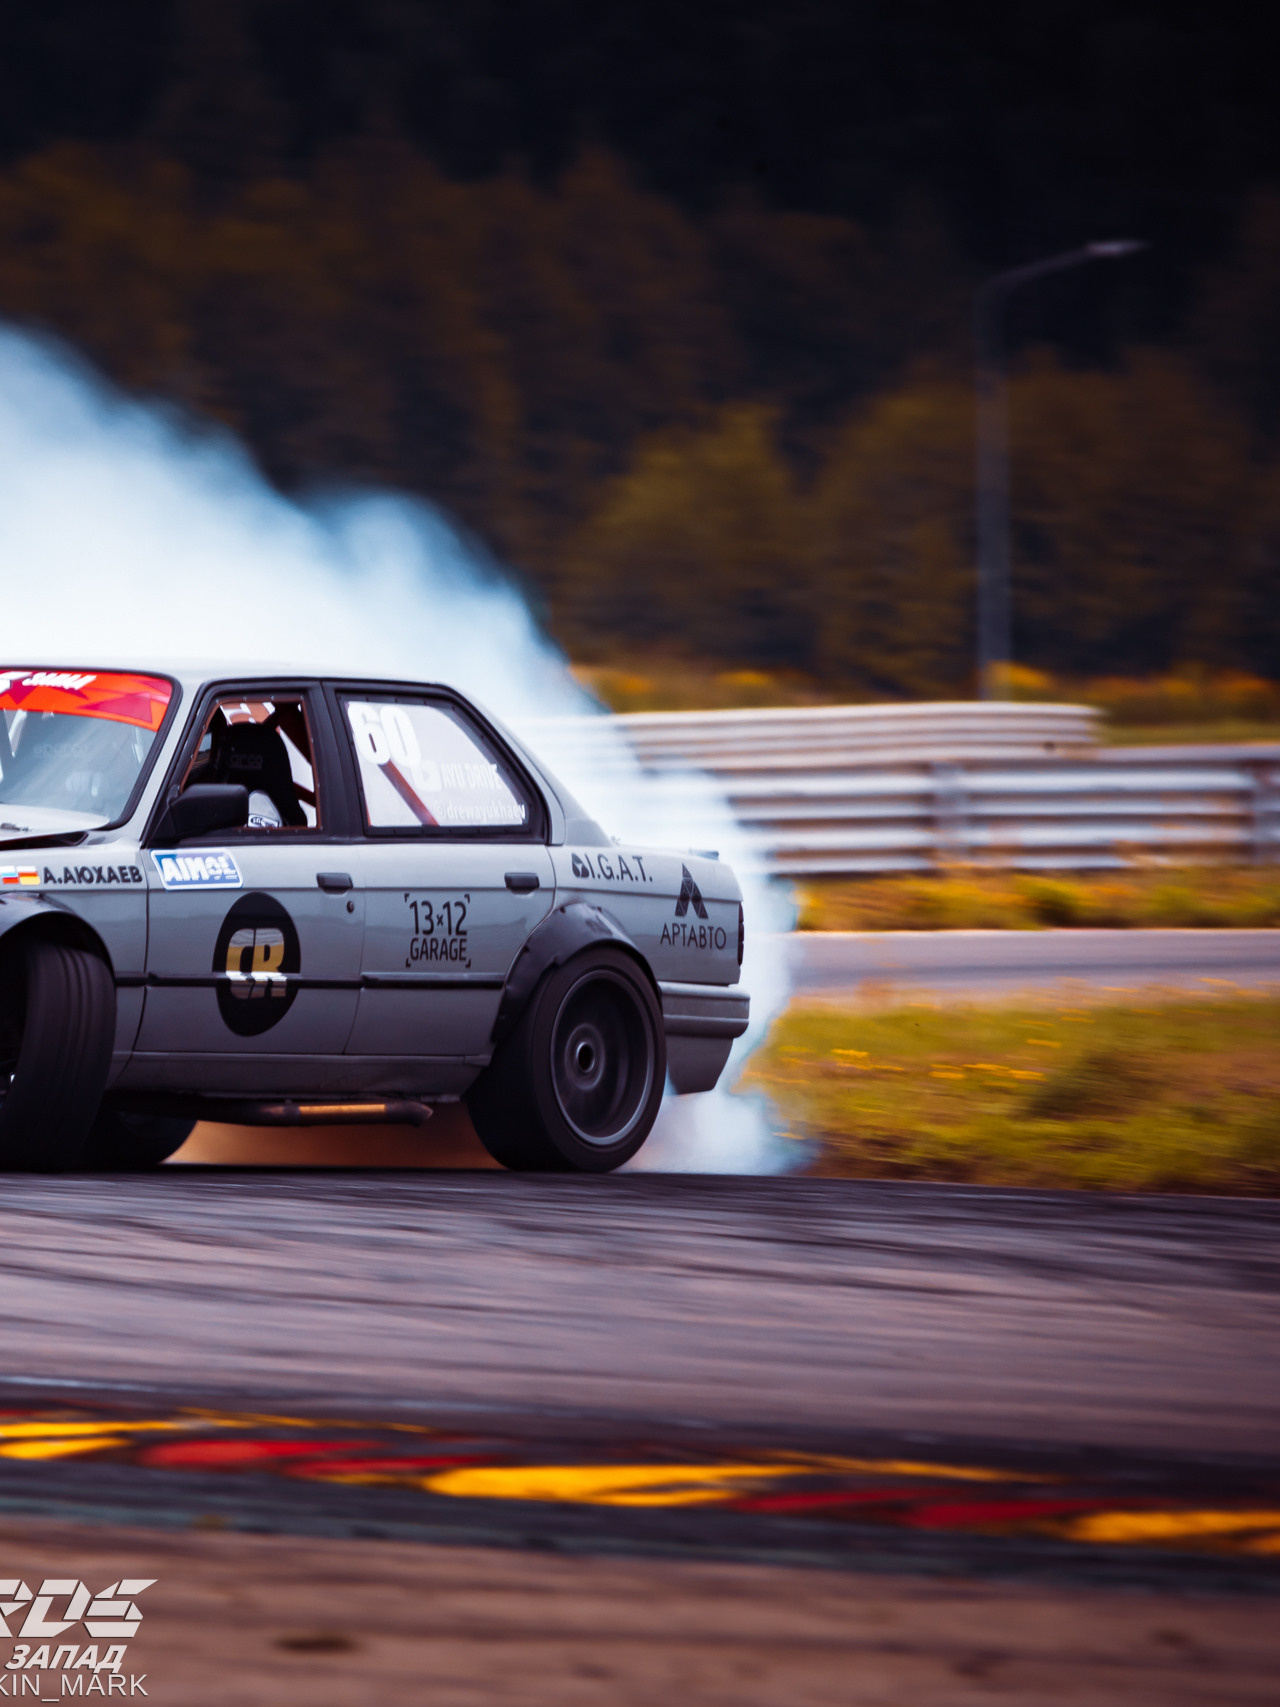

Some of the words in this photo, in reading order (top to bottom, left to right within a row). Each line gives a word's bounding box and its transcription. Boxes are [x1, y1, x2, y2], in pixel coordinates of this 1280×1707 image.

[348, 702, 422, 768] 60
[43, 865, 143, 886] А.АЮХАЕВ
[410, 938, 467, 961] GARAGE
